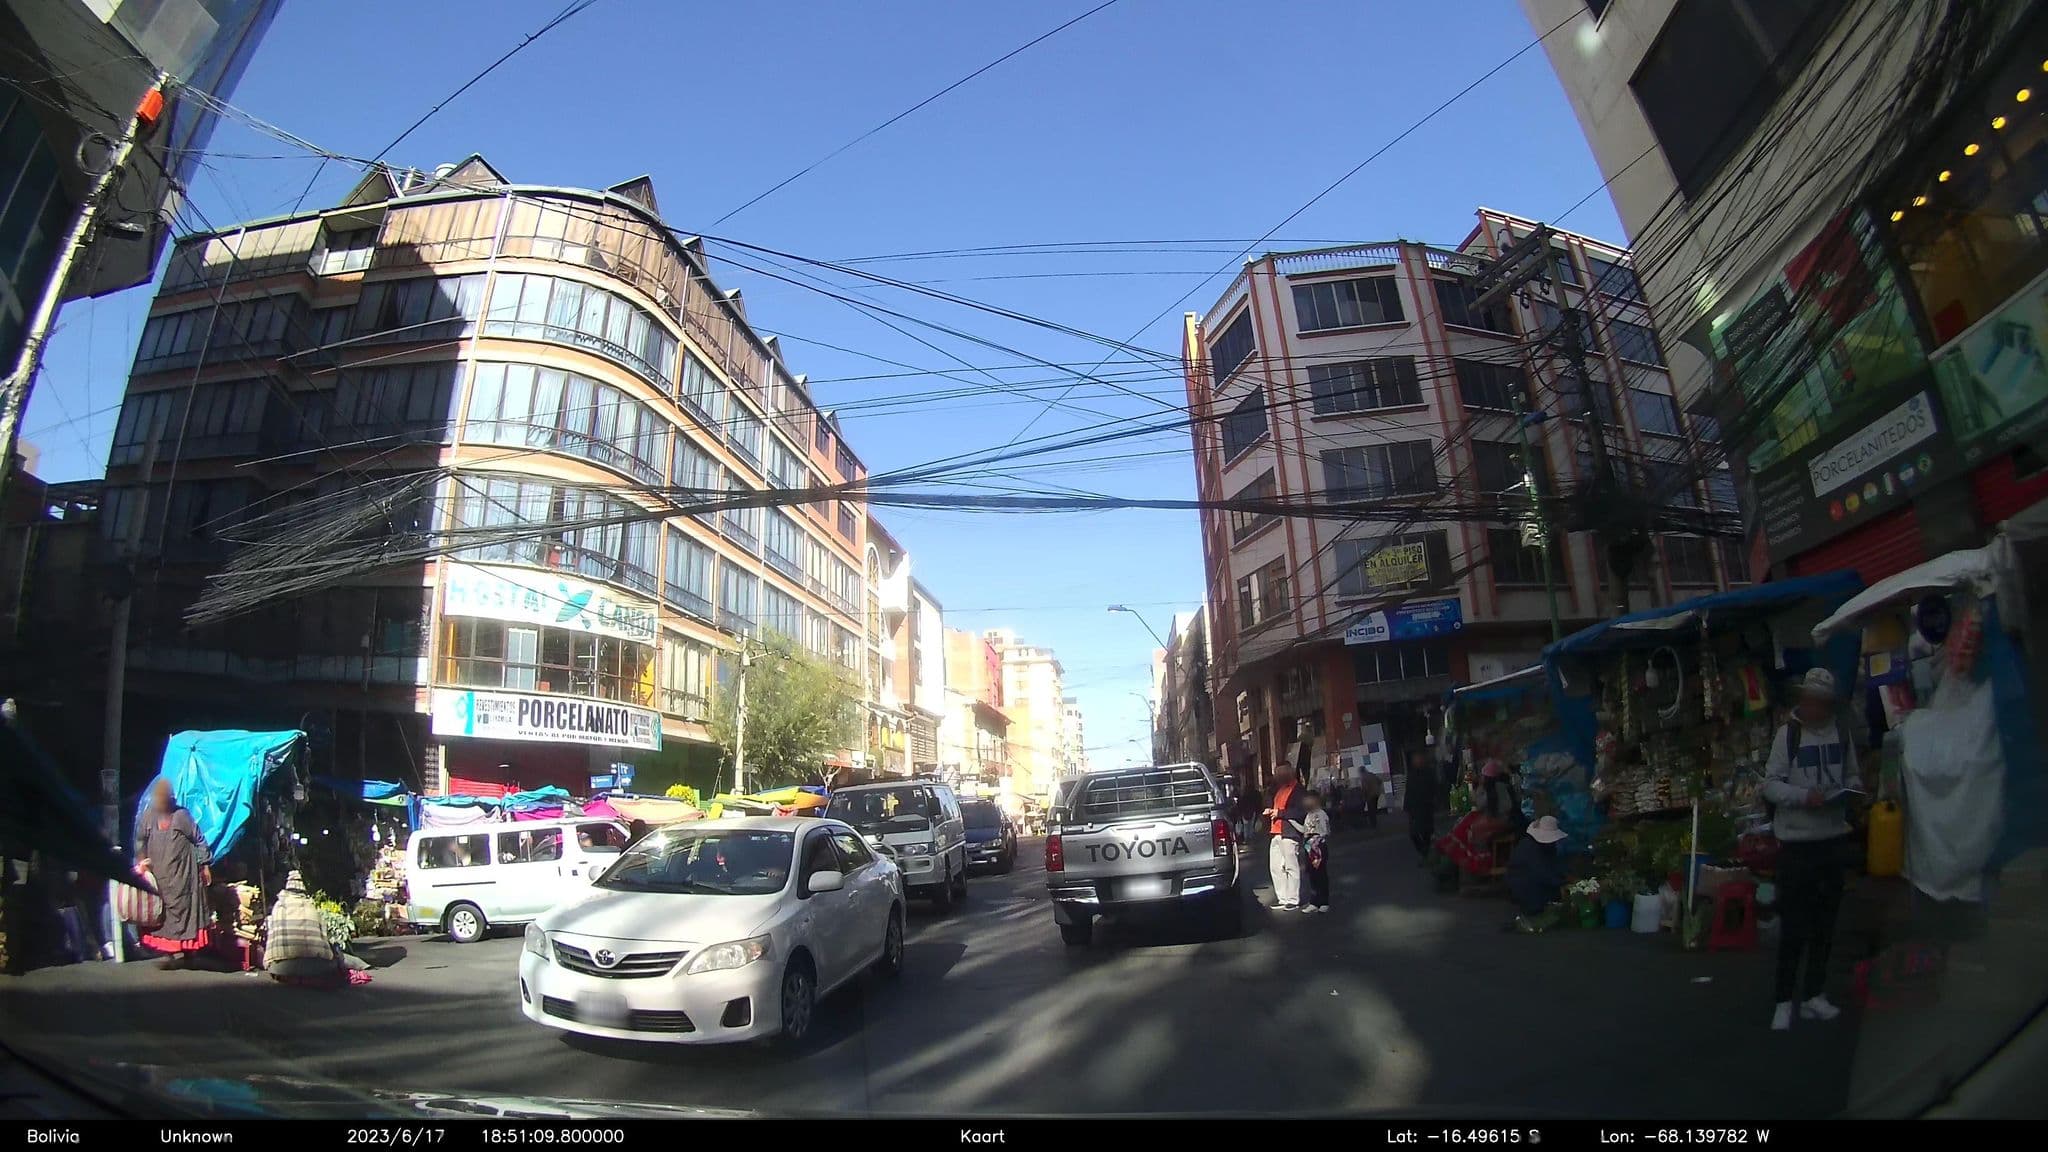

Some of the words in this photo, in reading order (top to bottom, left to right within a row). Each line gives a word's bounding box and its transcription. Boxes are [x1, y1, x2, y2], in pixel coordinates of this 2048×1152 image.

[1364, 560, 1376, 569] EN
[1380, 554, 1424, 567] ALQUILER
[518, 698, 629, 736] PORCELANATO
[1085, 837, 1190, 862] TOYOTA
